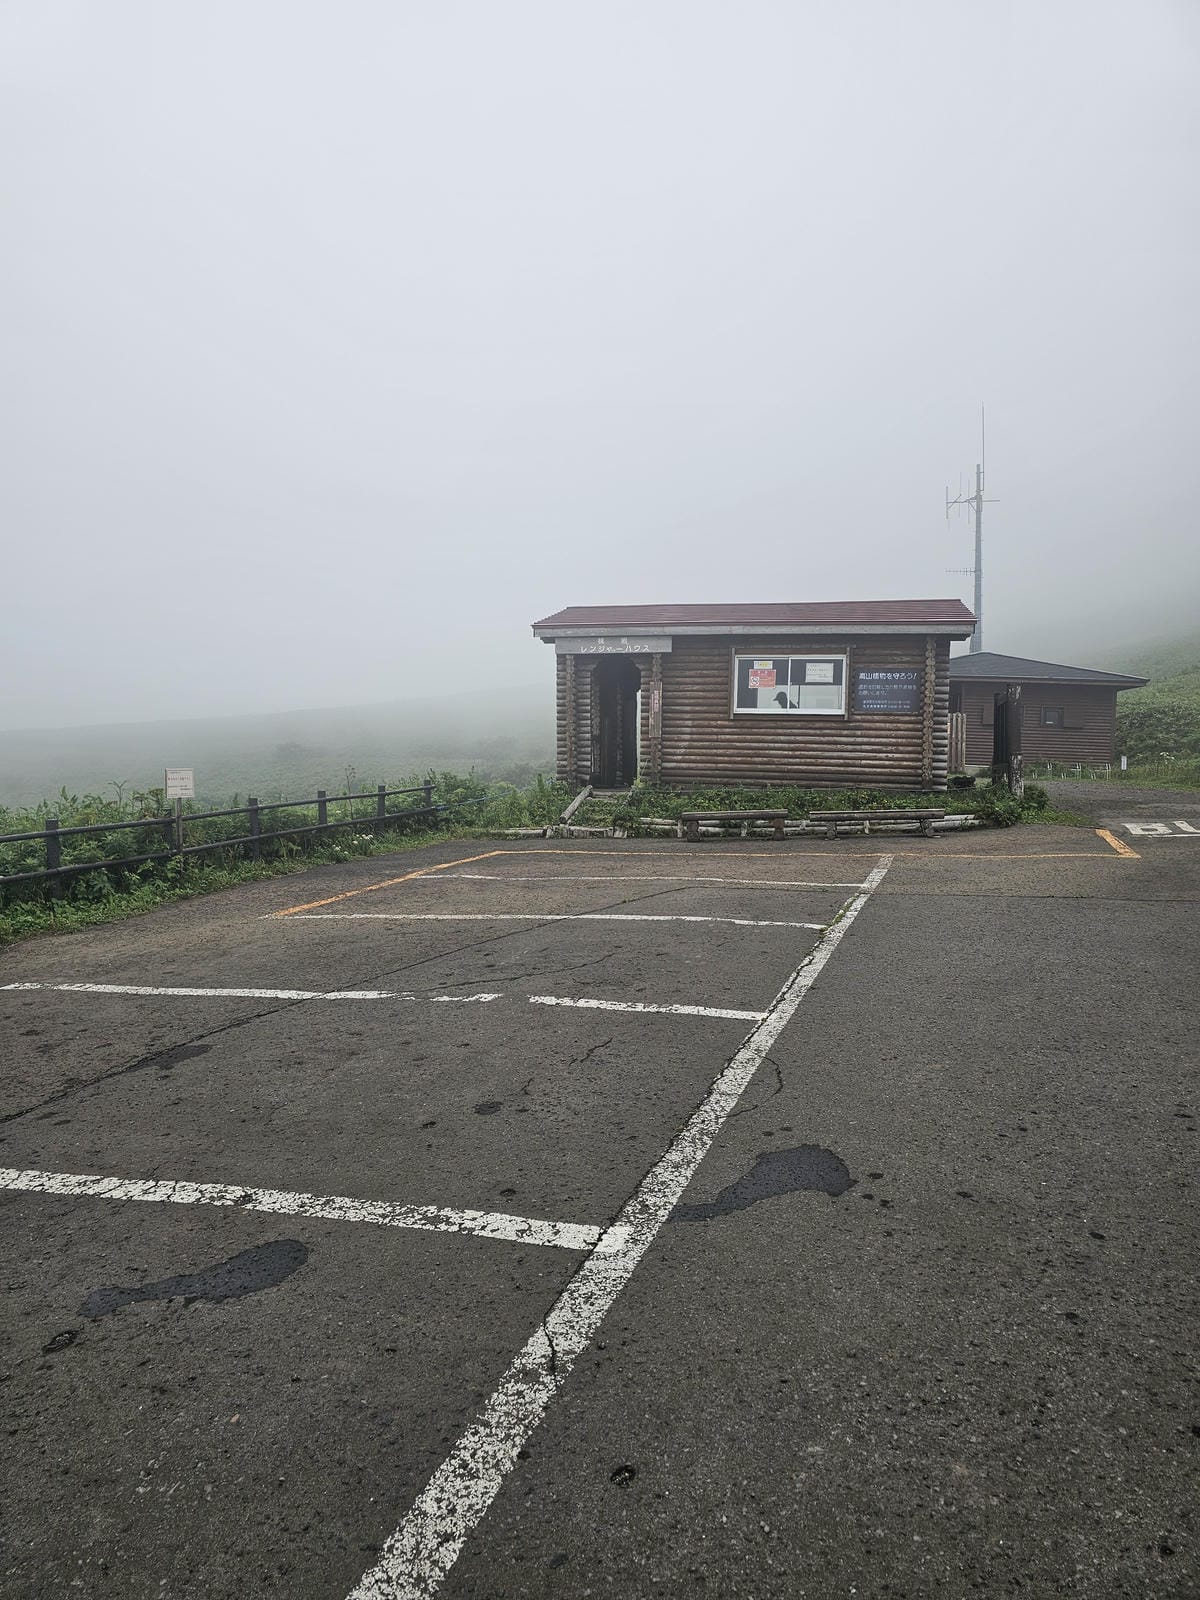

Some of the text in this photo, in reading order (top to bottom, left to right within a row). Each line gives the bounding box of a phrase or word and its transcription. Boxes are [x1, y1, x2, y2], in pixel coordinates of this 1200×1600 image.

[580, 645, 650, 653] レンジャーハウス
